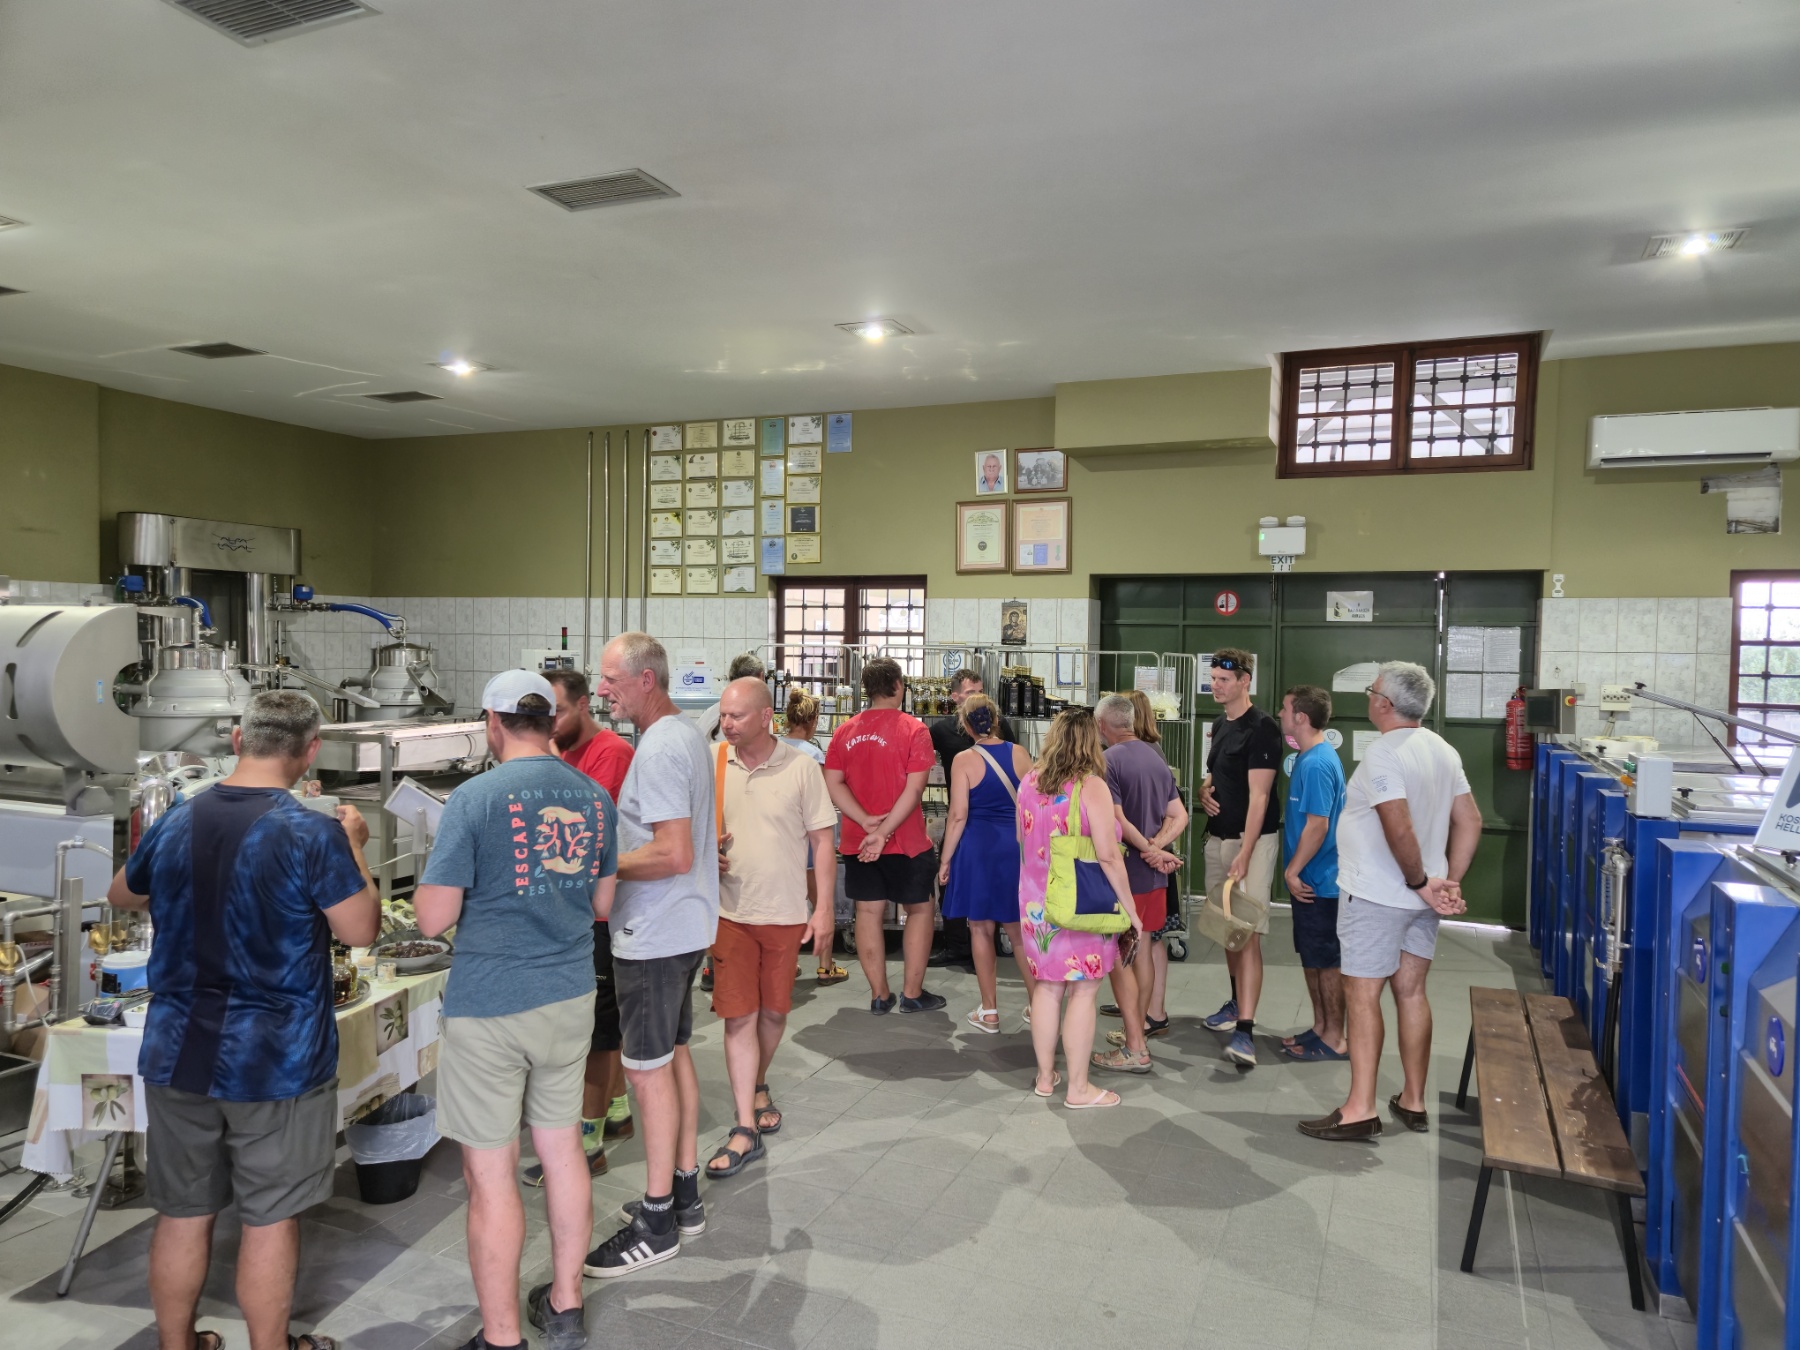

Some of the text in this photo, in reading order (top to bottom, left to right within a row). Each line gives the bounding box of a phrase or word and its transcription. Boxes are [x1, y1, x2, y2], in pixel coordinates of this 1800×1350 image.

[1271, 555, 1294, 564] EXIT
[521, 789, 593, 799] ON YOUR
[508, 802, 529, 887] ESCAPE
[558, 877, 588, 889] 199
